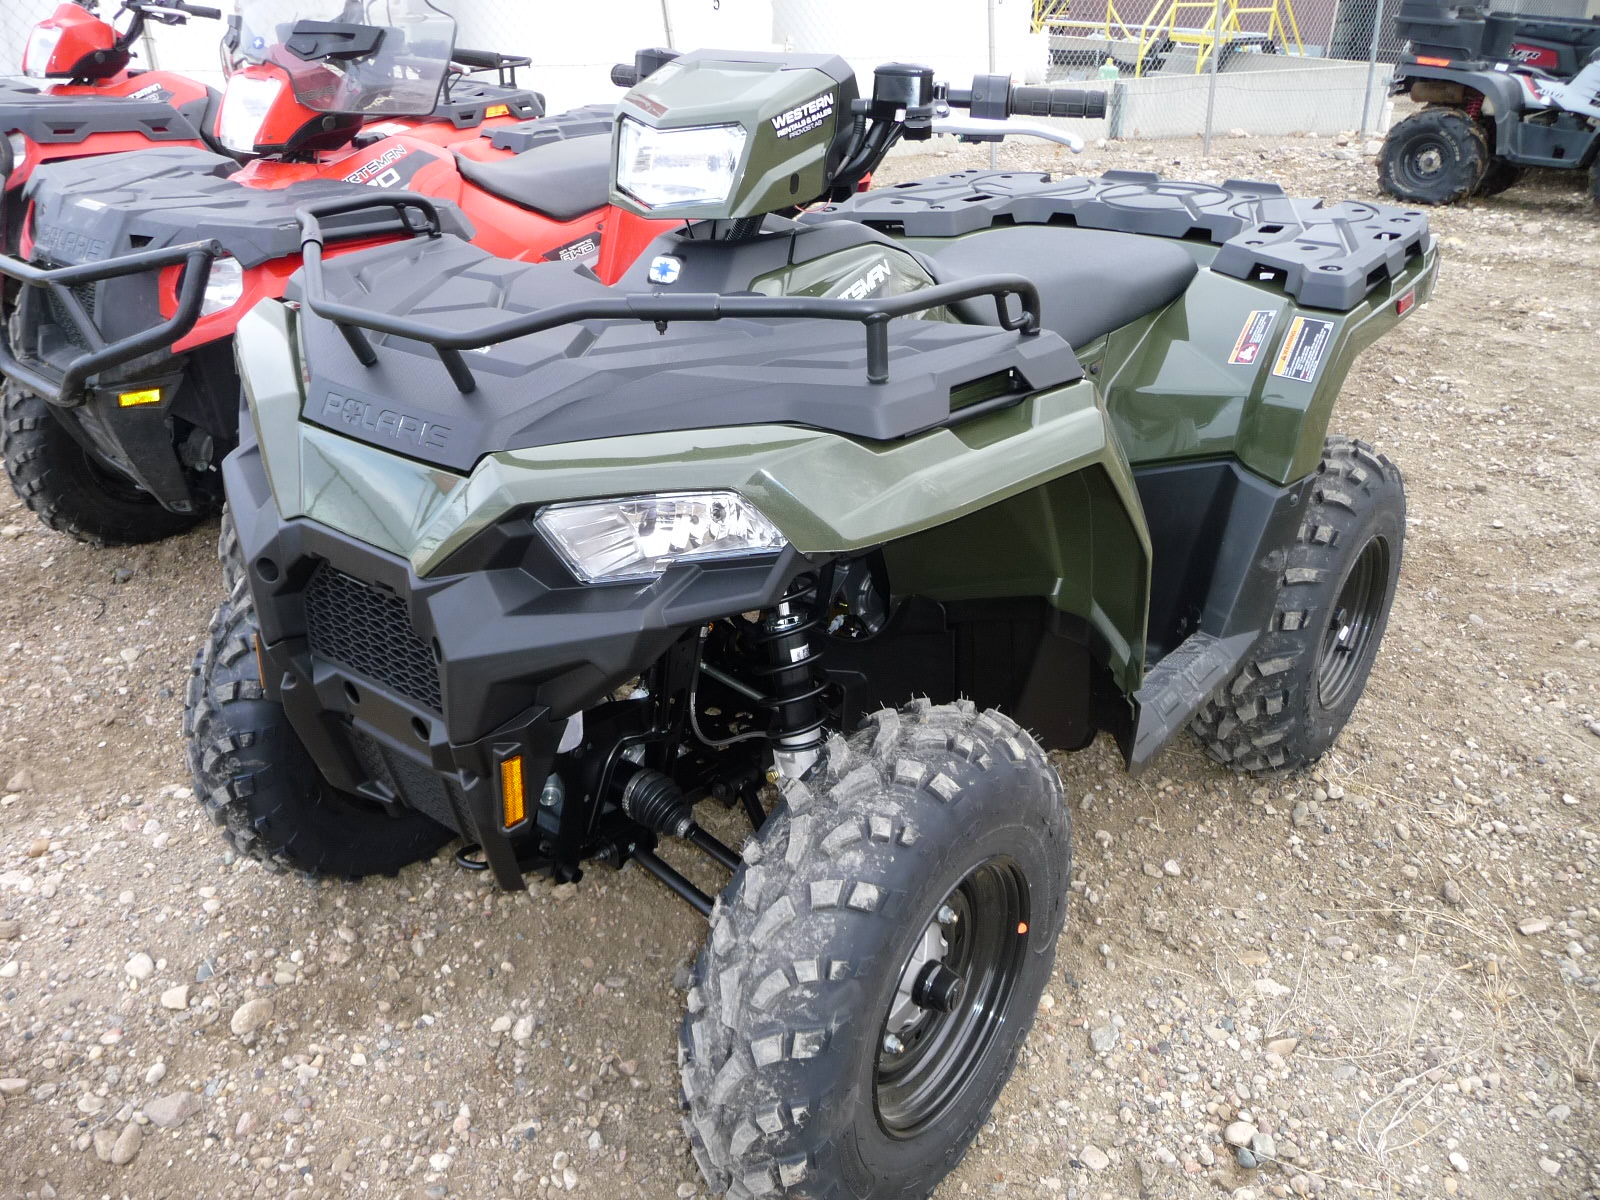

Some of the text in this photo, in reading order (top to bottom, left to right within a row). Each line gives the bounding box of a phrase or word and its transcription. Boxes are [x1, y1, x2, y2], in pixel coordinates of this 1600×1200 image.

[771, 92, 834, 129] WESTERN
[776, 119, 807, 138] RENTALS
[811, 107, 832, 122] SALES
[342, 144, 408, 184] RTSMAN
[836, 258, 891, 300] TSMAN
[321, 391, 452, 450] POLARIS
